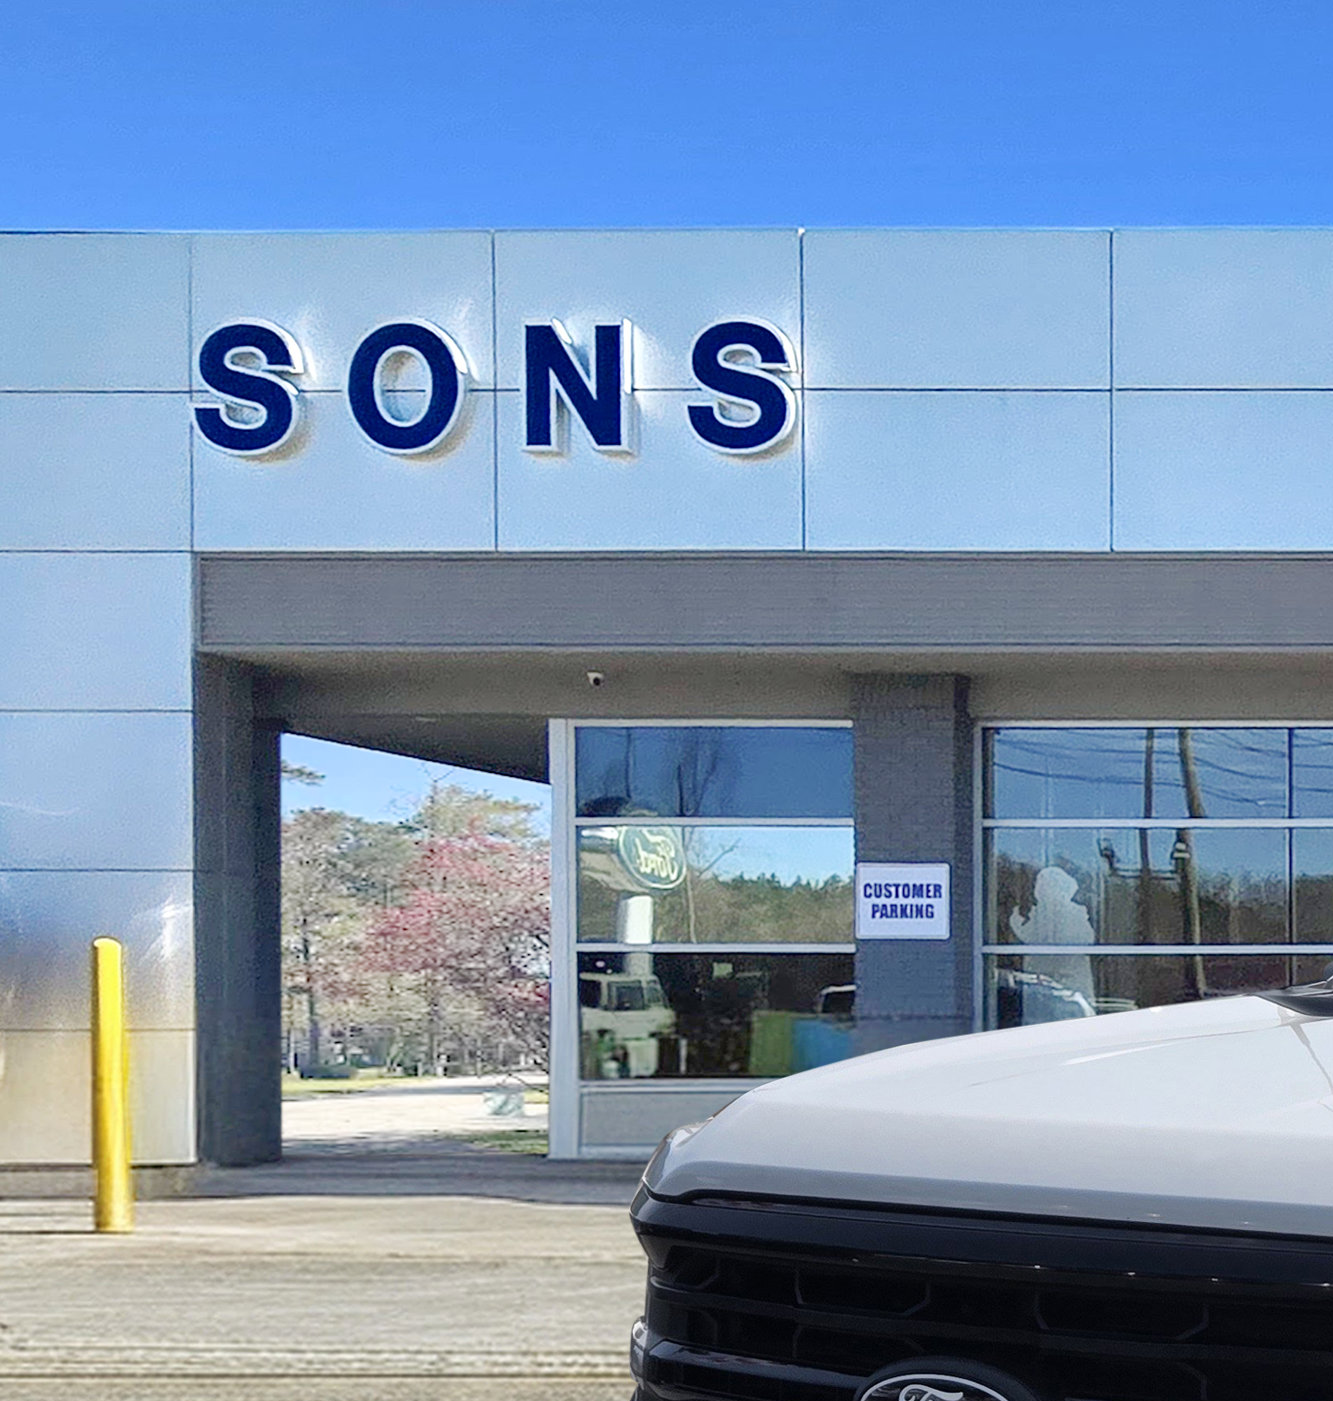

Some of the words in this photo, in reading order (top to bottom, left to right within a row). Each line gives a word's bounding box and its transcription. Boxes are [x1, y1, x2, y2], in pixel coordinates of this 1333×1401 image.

[193, 318, 795, 453] SONS
[863, 882, 943, 899] CUSTOMER
[871, 903, 935, 919] PARKING
